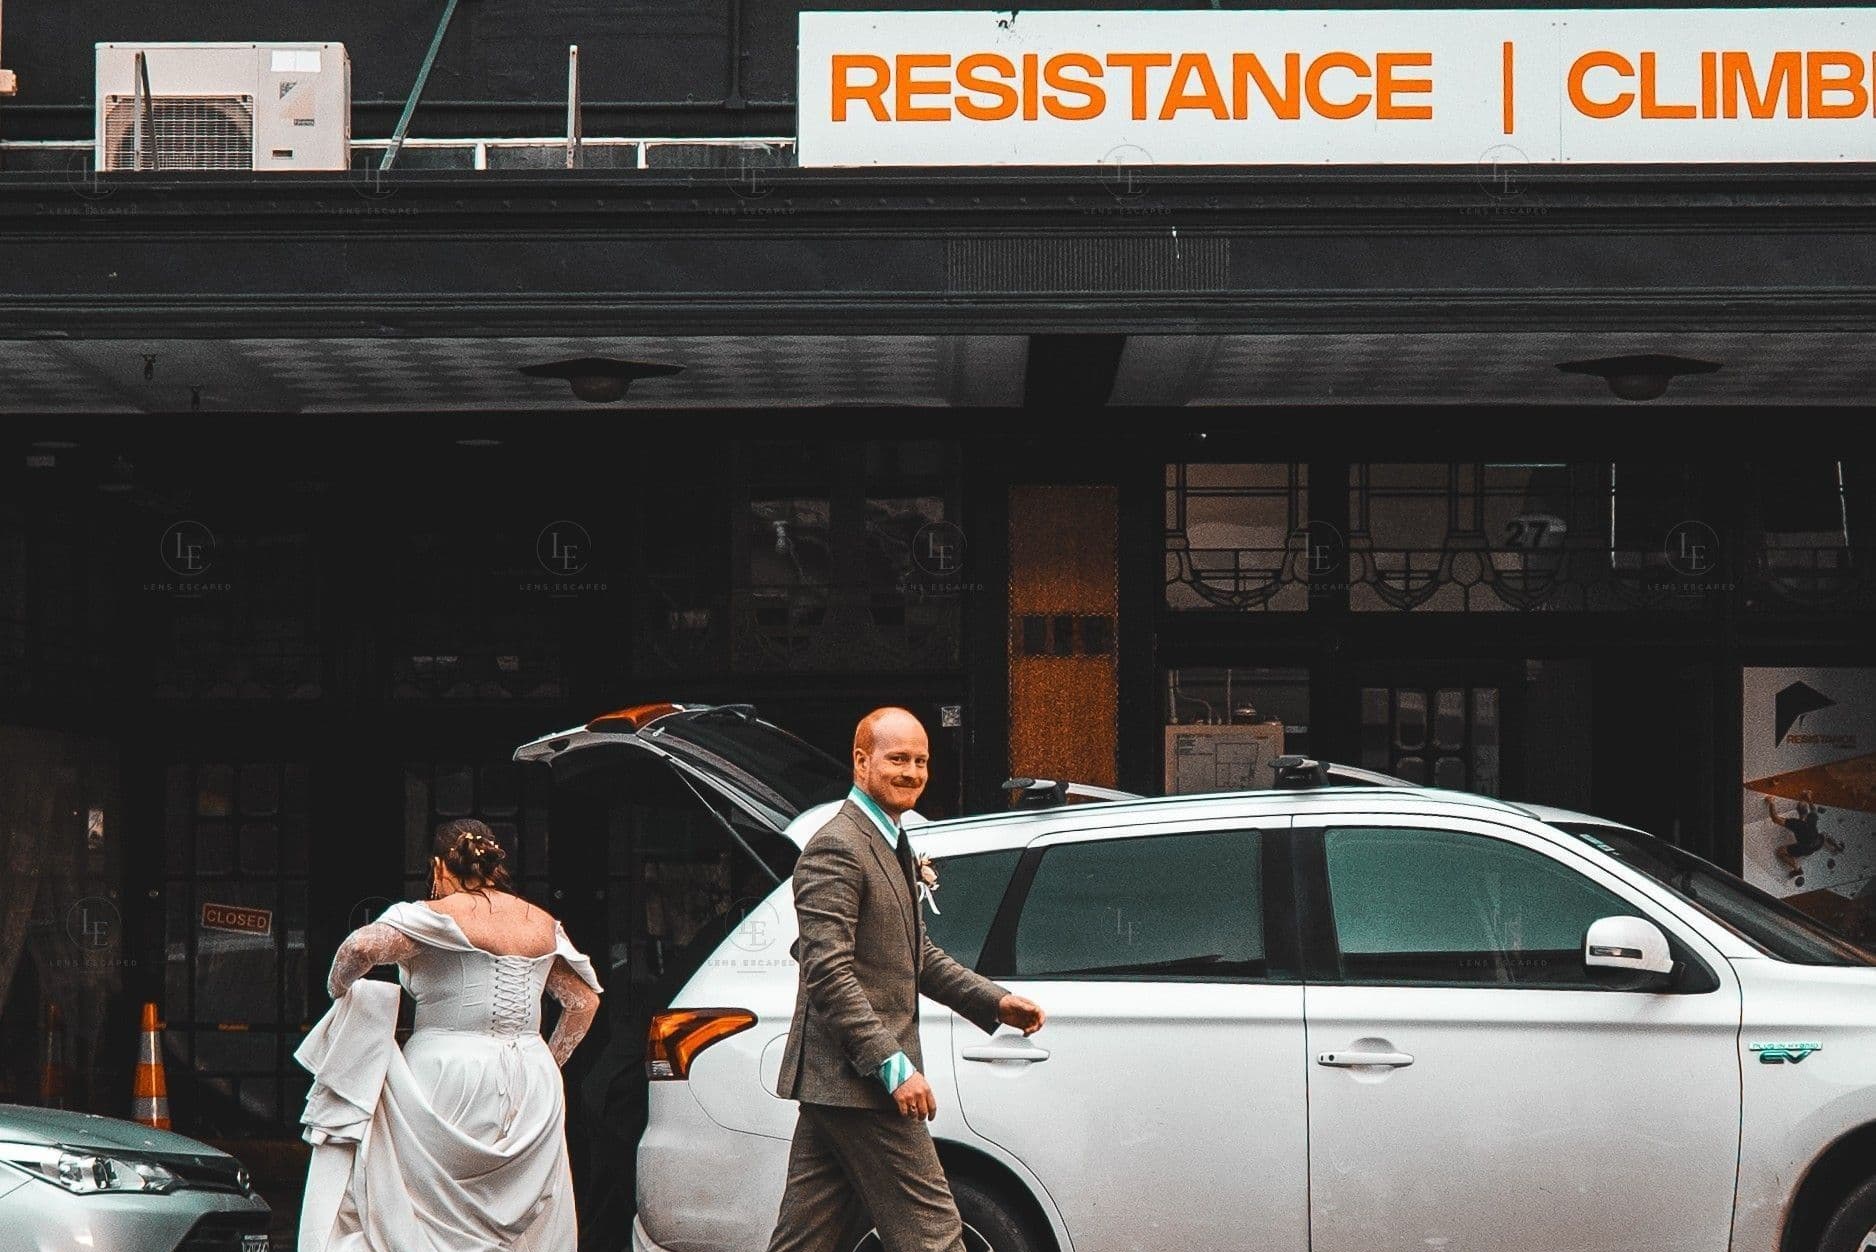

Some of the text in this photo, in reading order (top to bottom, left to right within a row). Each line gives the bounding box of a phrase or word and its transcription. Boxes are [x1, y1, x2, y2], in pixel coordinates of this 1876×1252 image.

[831, 52, 1433, 122] RESISTANCE
[1567, 50, 1876, 119] CLIMB
[1504, 521, 1548, 547] 27
[206, 908, 267, 929] CLOSED
